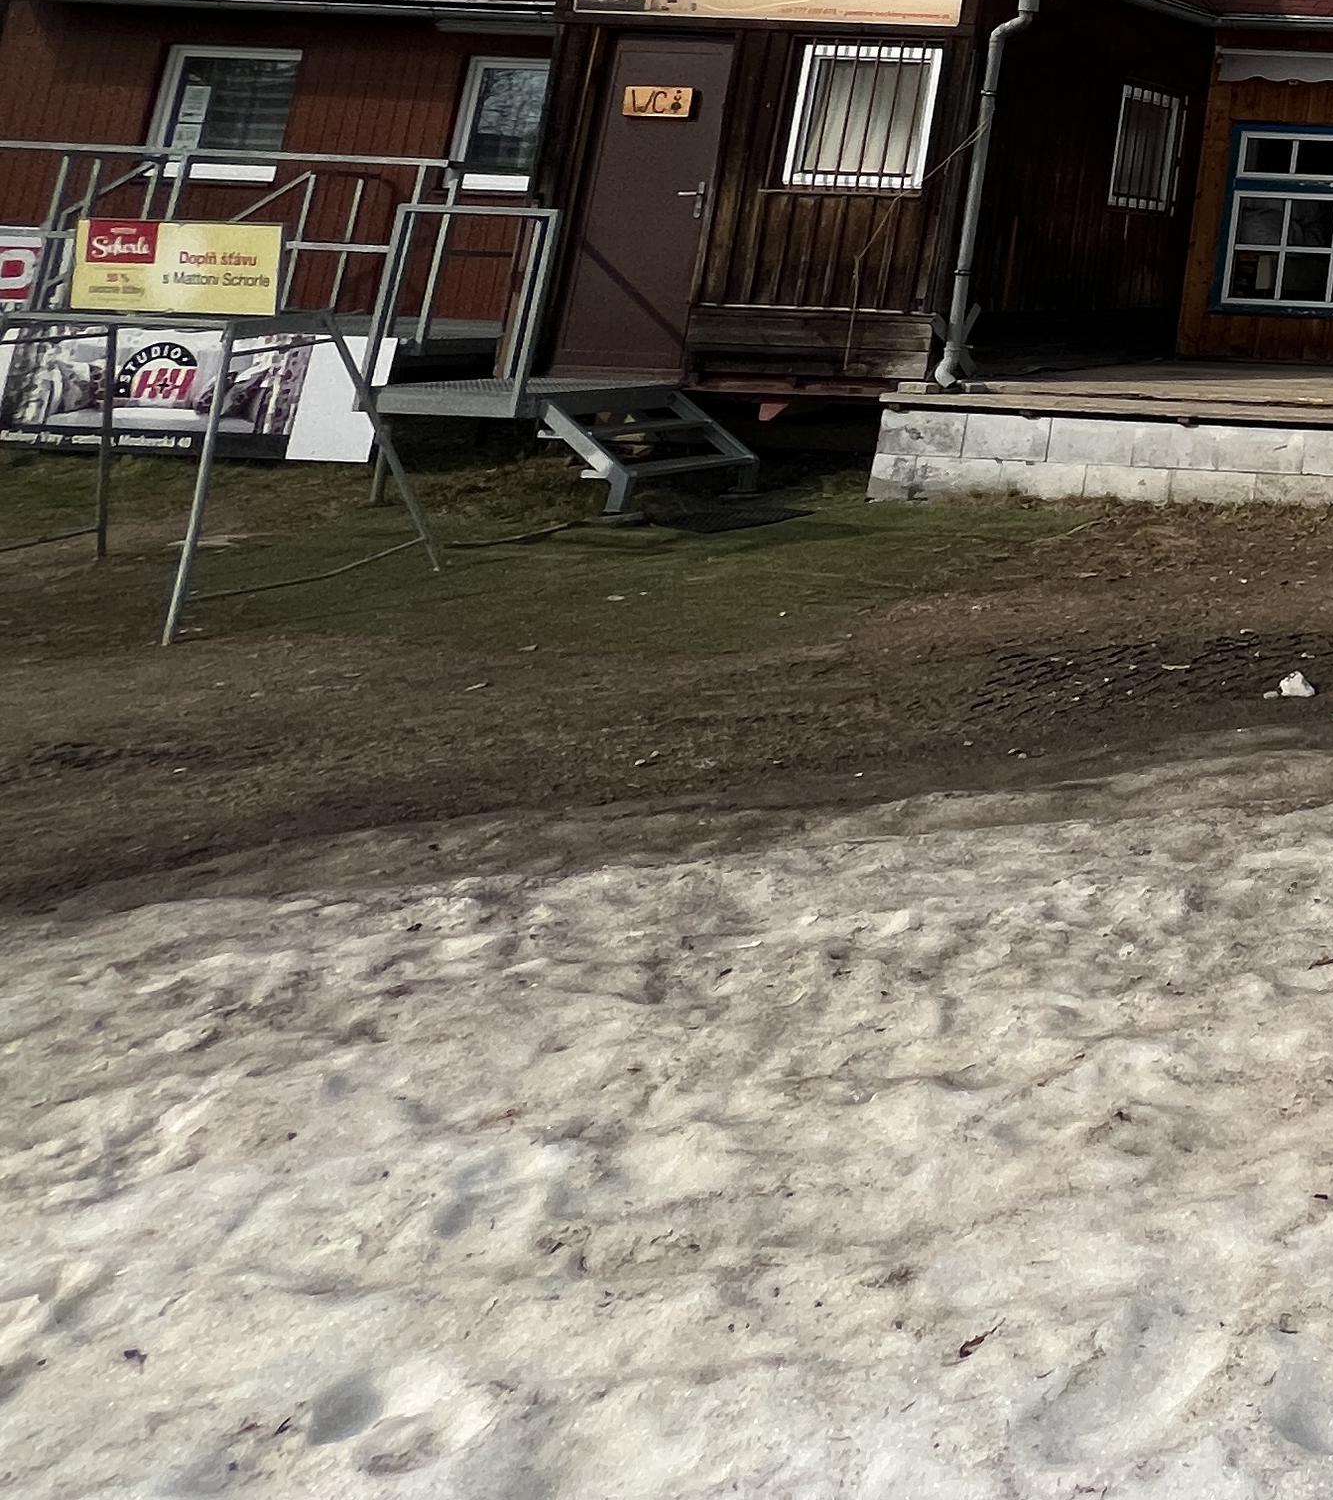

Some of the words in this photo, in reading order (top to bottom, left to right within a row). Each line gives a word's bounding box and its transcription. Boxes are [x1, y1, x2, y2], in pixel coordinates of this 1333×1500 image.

[631, 89, 667, 113] WC
[222, 272, 271, 287] Schorle
[119, 344, 183, 384] STUDIO
